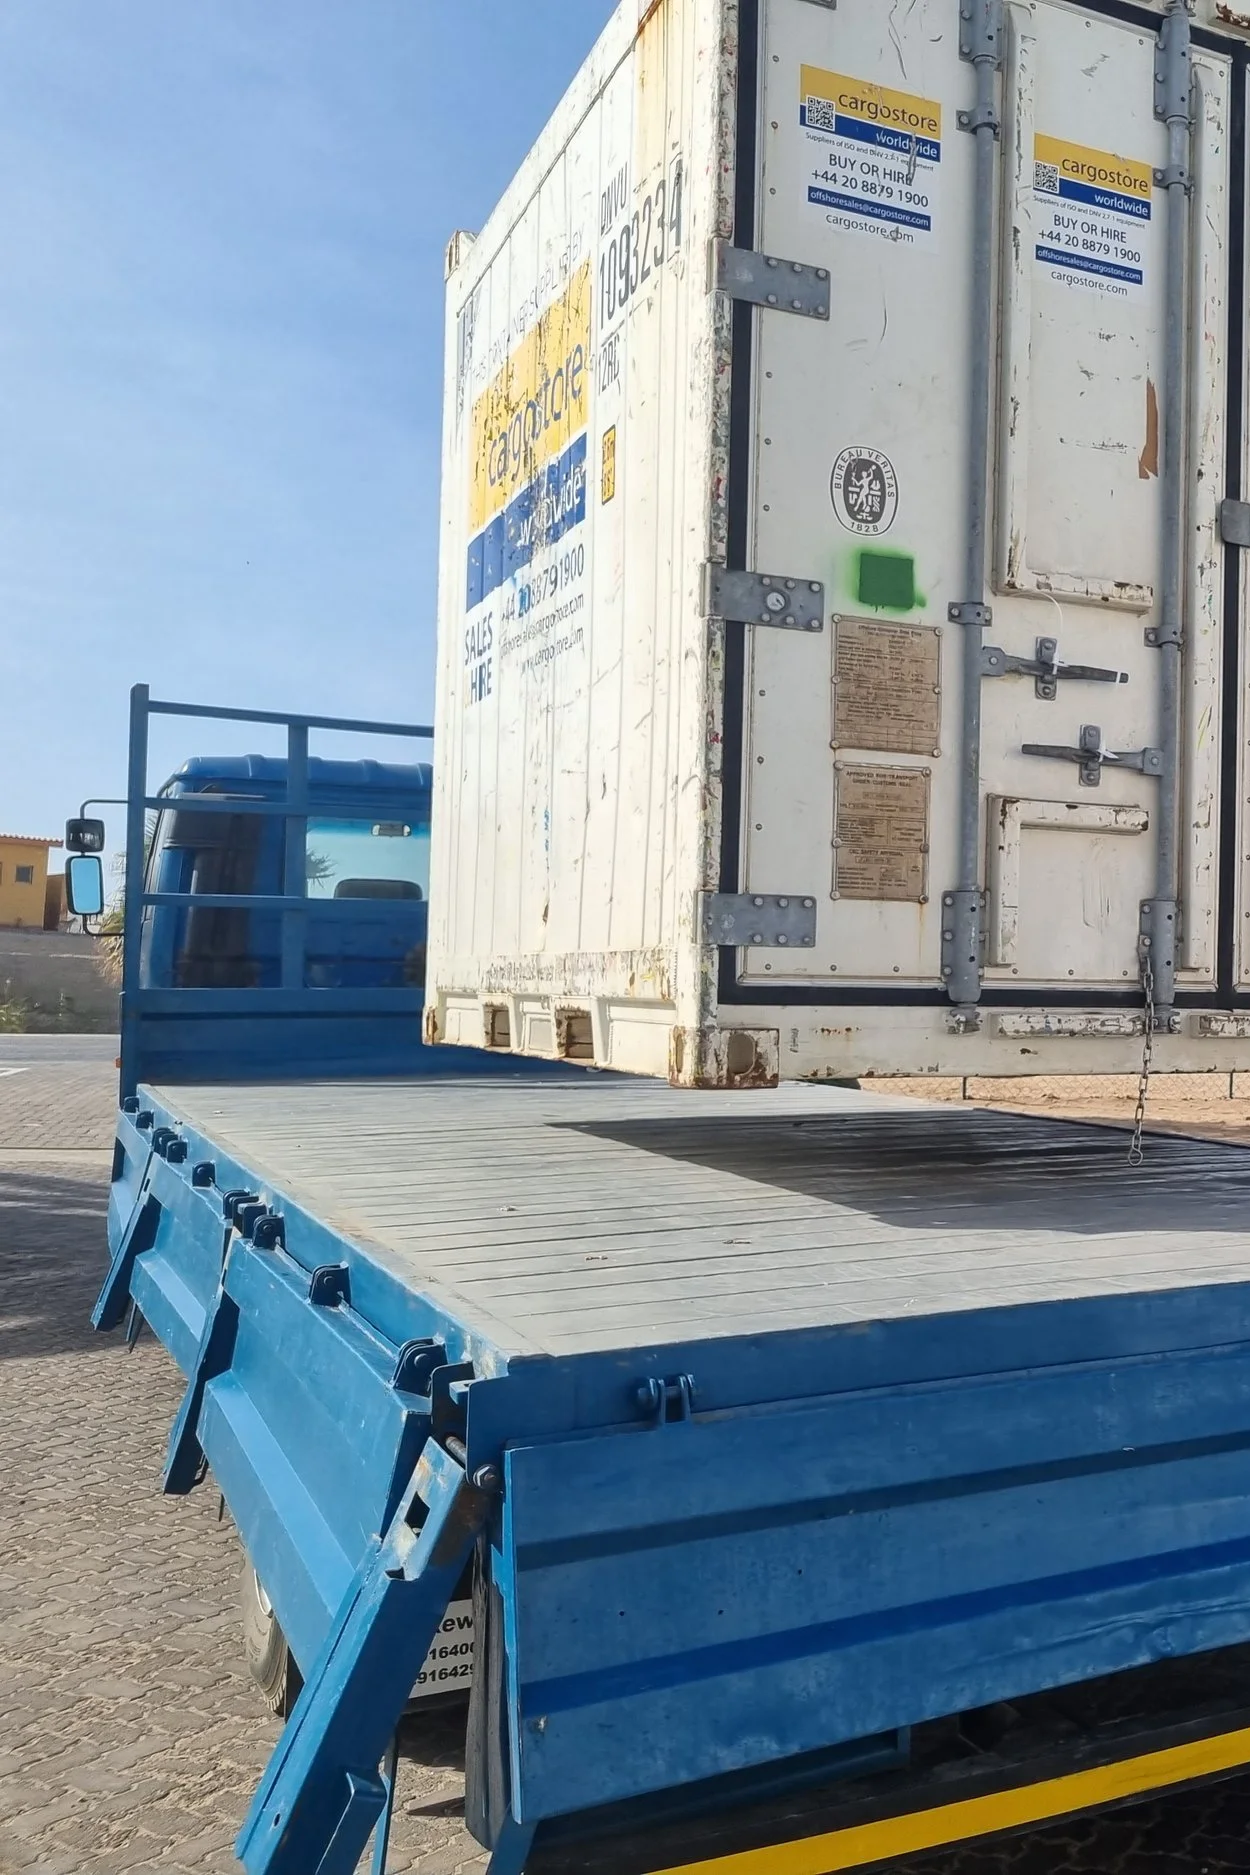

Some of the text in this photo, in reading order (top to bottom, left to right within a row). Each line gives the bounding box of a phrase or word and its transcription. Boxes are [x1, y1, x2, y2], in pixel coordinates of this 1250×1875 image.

[838, 94, 937, 132] cargostore
[805, 132, 835, 147] Suppliers
[844, 142, 855, 151] ISO
[856, 145, 868, 155] and
[829, 153, 911, 186] BUY OR HIRE
[1062, 158, 1148, 192] cargostore
[600, 162, 628, 237] DNVU
[811, 169, 928, 208] +44 20 8879 1900
[1094, 194, 1148, 217] worldwide
[810, 189, 930, 227] offshoresales@cargostore.com
[600, 159, 684, 330] 1093234
[826, 214, 914, 243] cargostore.com
[1054, 214, 1127, 243] BUY OR HIRE
[1038, 229, 1141, 263] +44 20 8879 1900
[1038, 249, 1141, 281] offshoresales@cargostore.com
[1051, 270, 1128, 296] cargostore.com
[834, 449, 895, 498] BUREAU VERITAS
[851, 521, 879, 533] 1828
[560, 543, 584, 591] 1900
[465, 611, 492, 665] SALES
[471, 657, 492, 704] HIRE
[439, 1615, 473, 1633] ew
